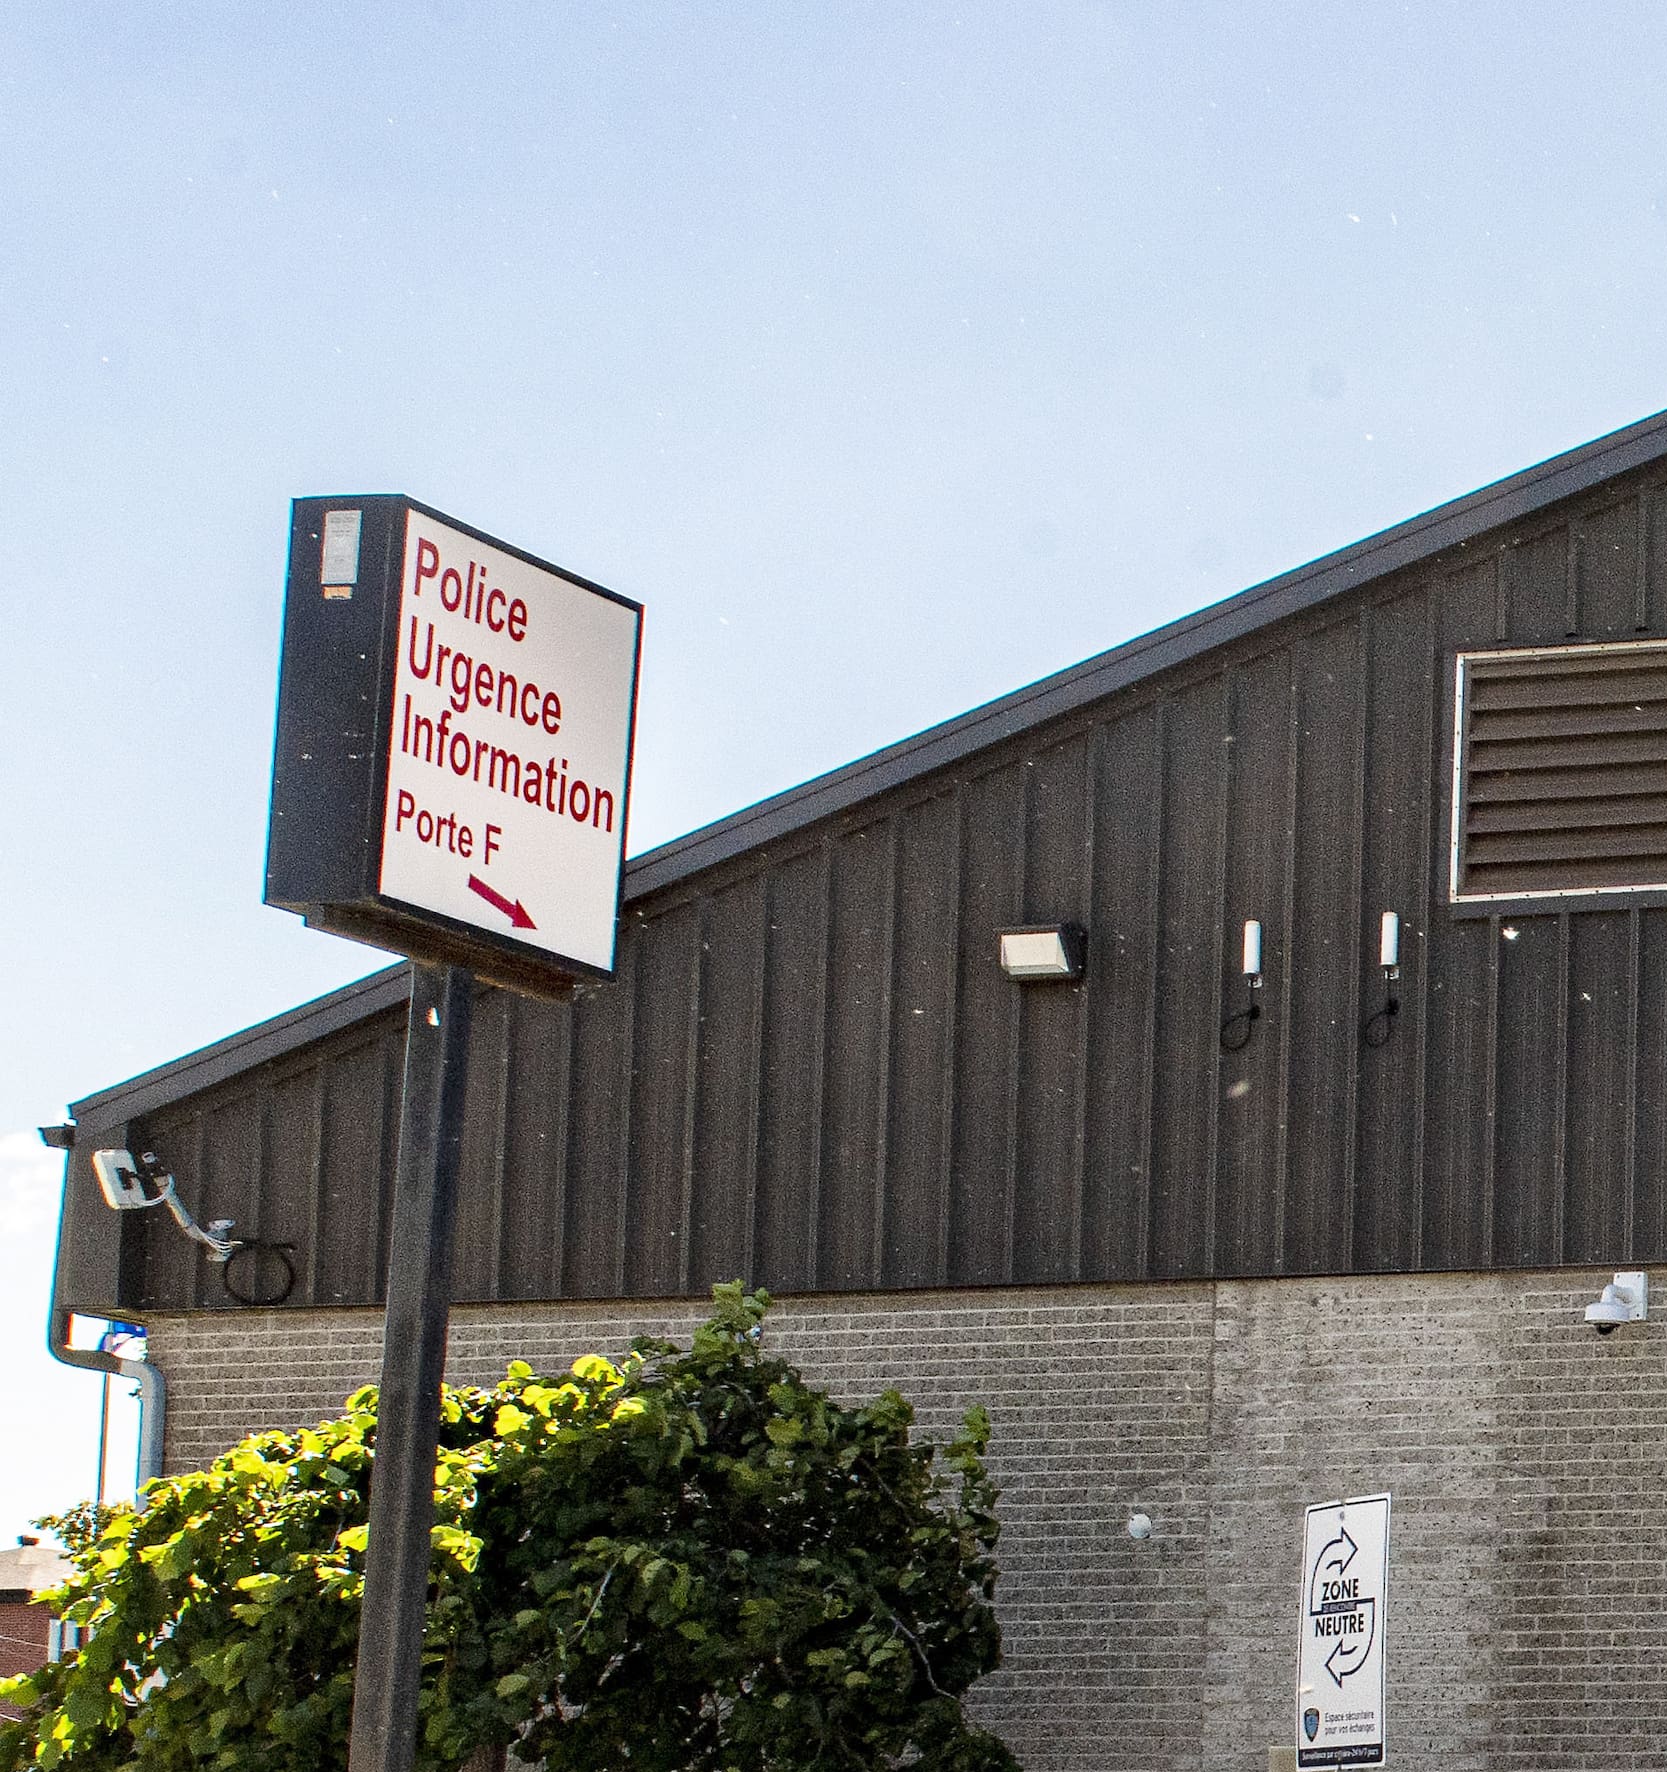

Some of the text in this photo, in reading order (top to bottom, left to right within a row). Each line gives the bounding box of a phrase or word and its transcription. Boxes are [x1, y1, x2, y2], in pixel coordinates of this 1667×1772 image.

[413, 537, 528, 642] Police
[408, 616, 562, 736] Urgence
[401, 693, 613, 832] Information
[395, 789, 502, 865] Porte F
[1322, 1578, 1359, 1601] ZONE
[1315, 1613, 1365, 1637] NEUTRE
[1325, 1711, 1343, 1723] Espace
[1325, 1726, 1337, 1736] pour
